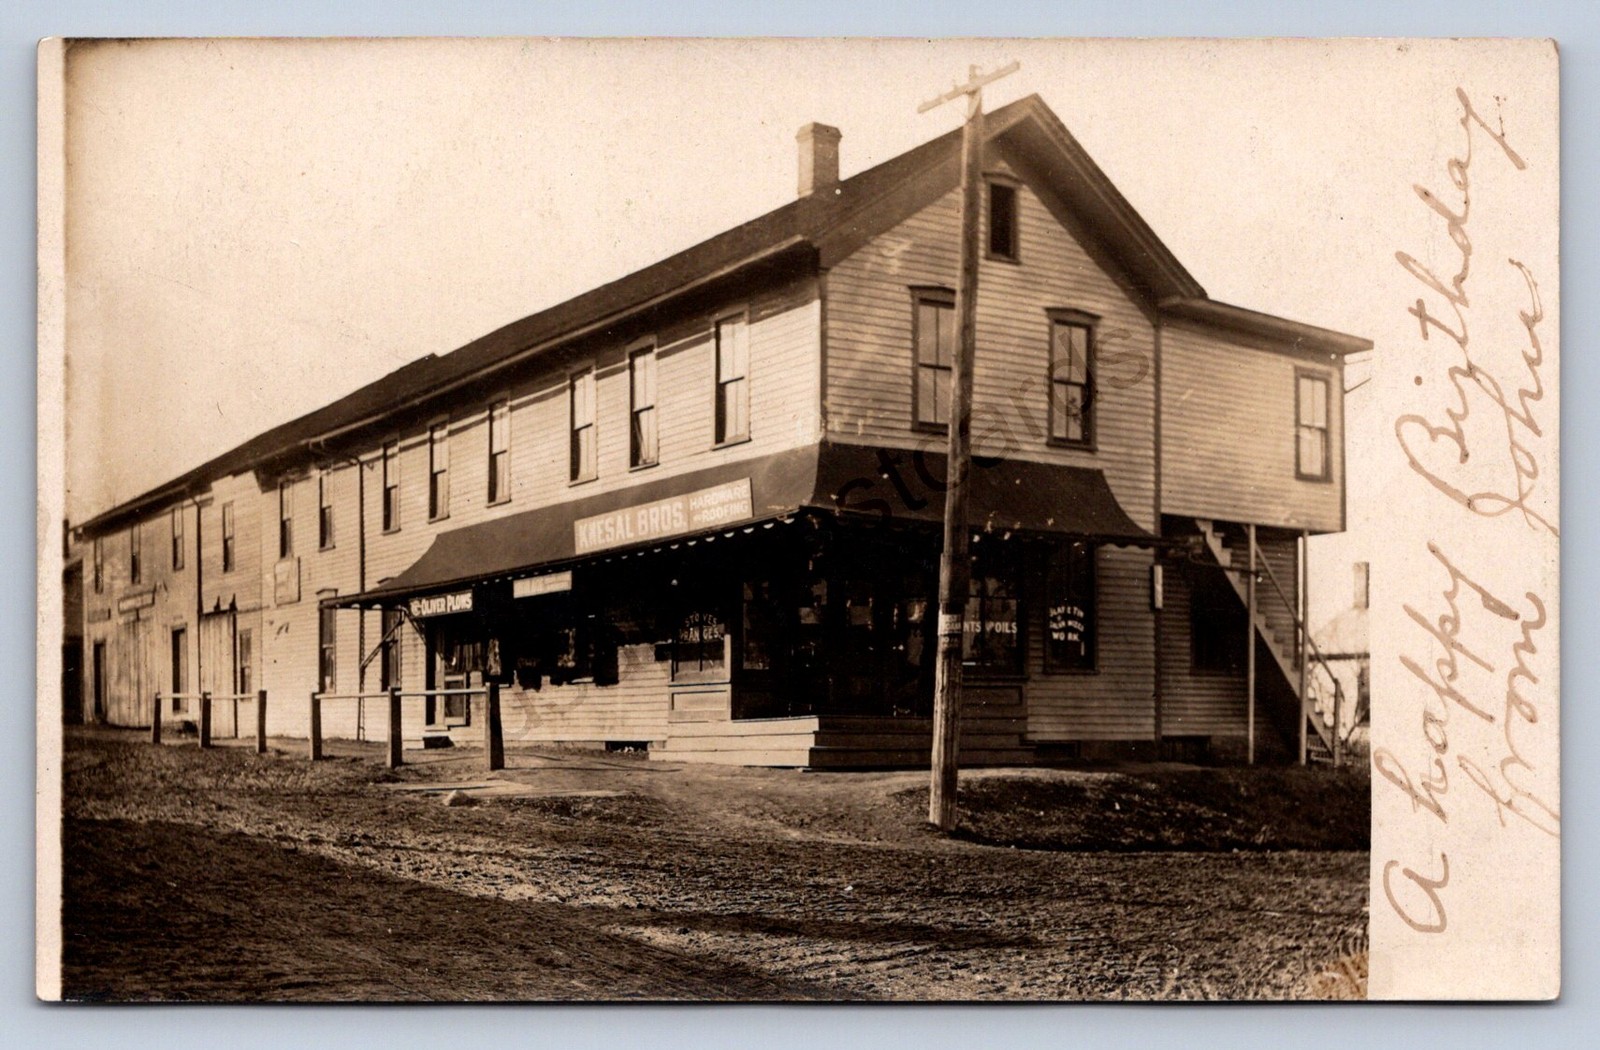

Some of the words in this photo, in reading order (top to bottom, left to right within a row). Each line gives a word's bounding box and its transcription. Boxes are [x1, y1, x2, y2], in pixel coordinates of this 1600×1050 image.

[1394, 86, 1527, 508] Birthday
[689, 485, 749, 511] HARDWARE
[702, 499, 749, 523] ROOFING
[637, 502, 688, 536] BROS.
[446, 593, 473, 613] PLOWS
[684, 611, 718, 627] STOVES
[994, 621, 1018, 634] OILS
[1374, 541, 1520, 823] happy
[1457, 590, 1560, 837] from
